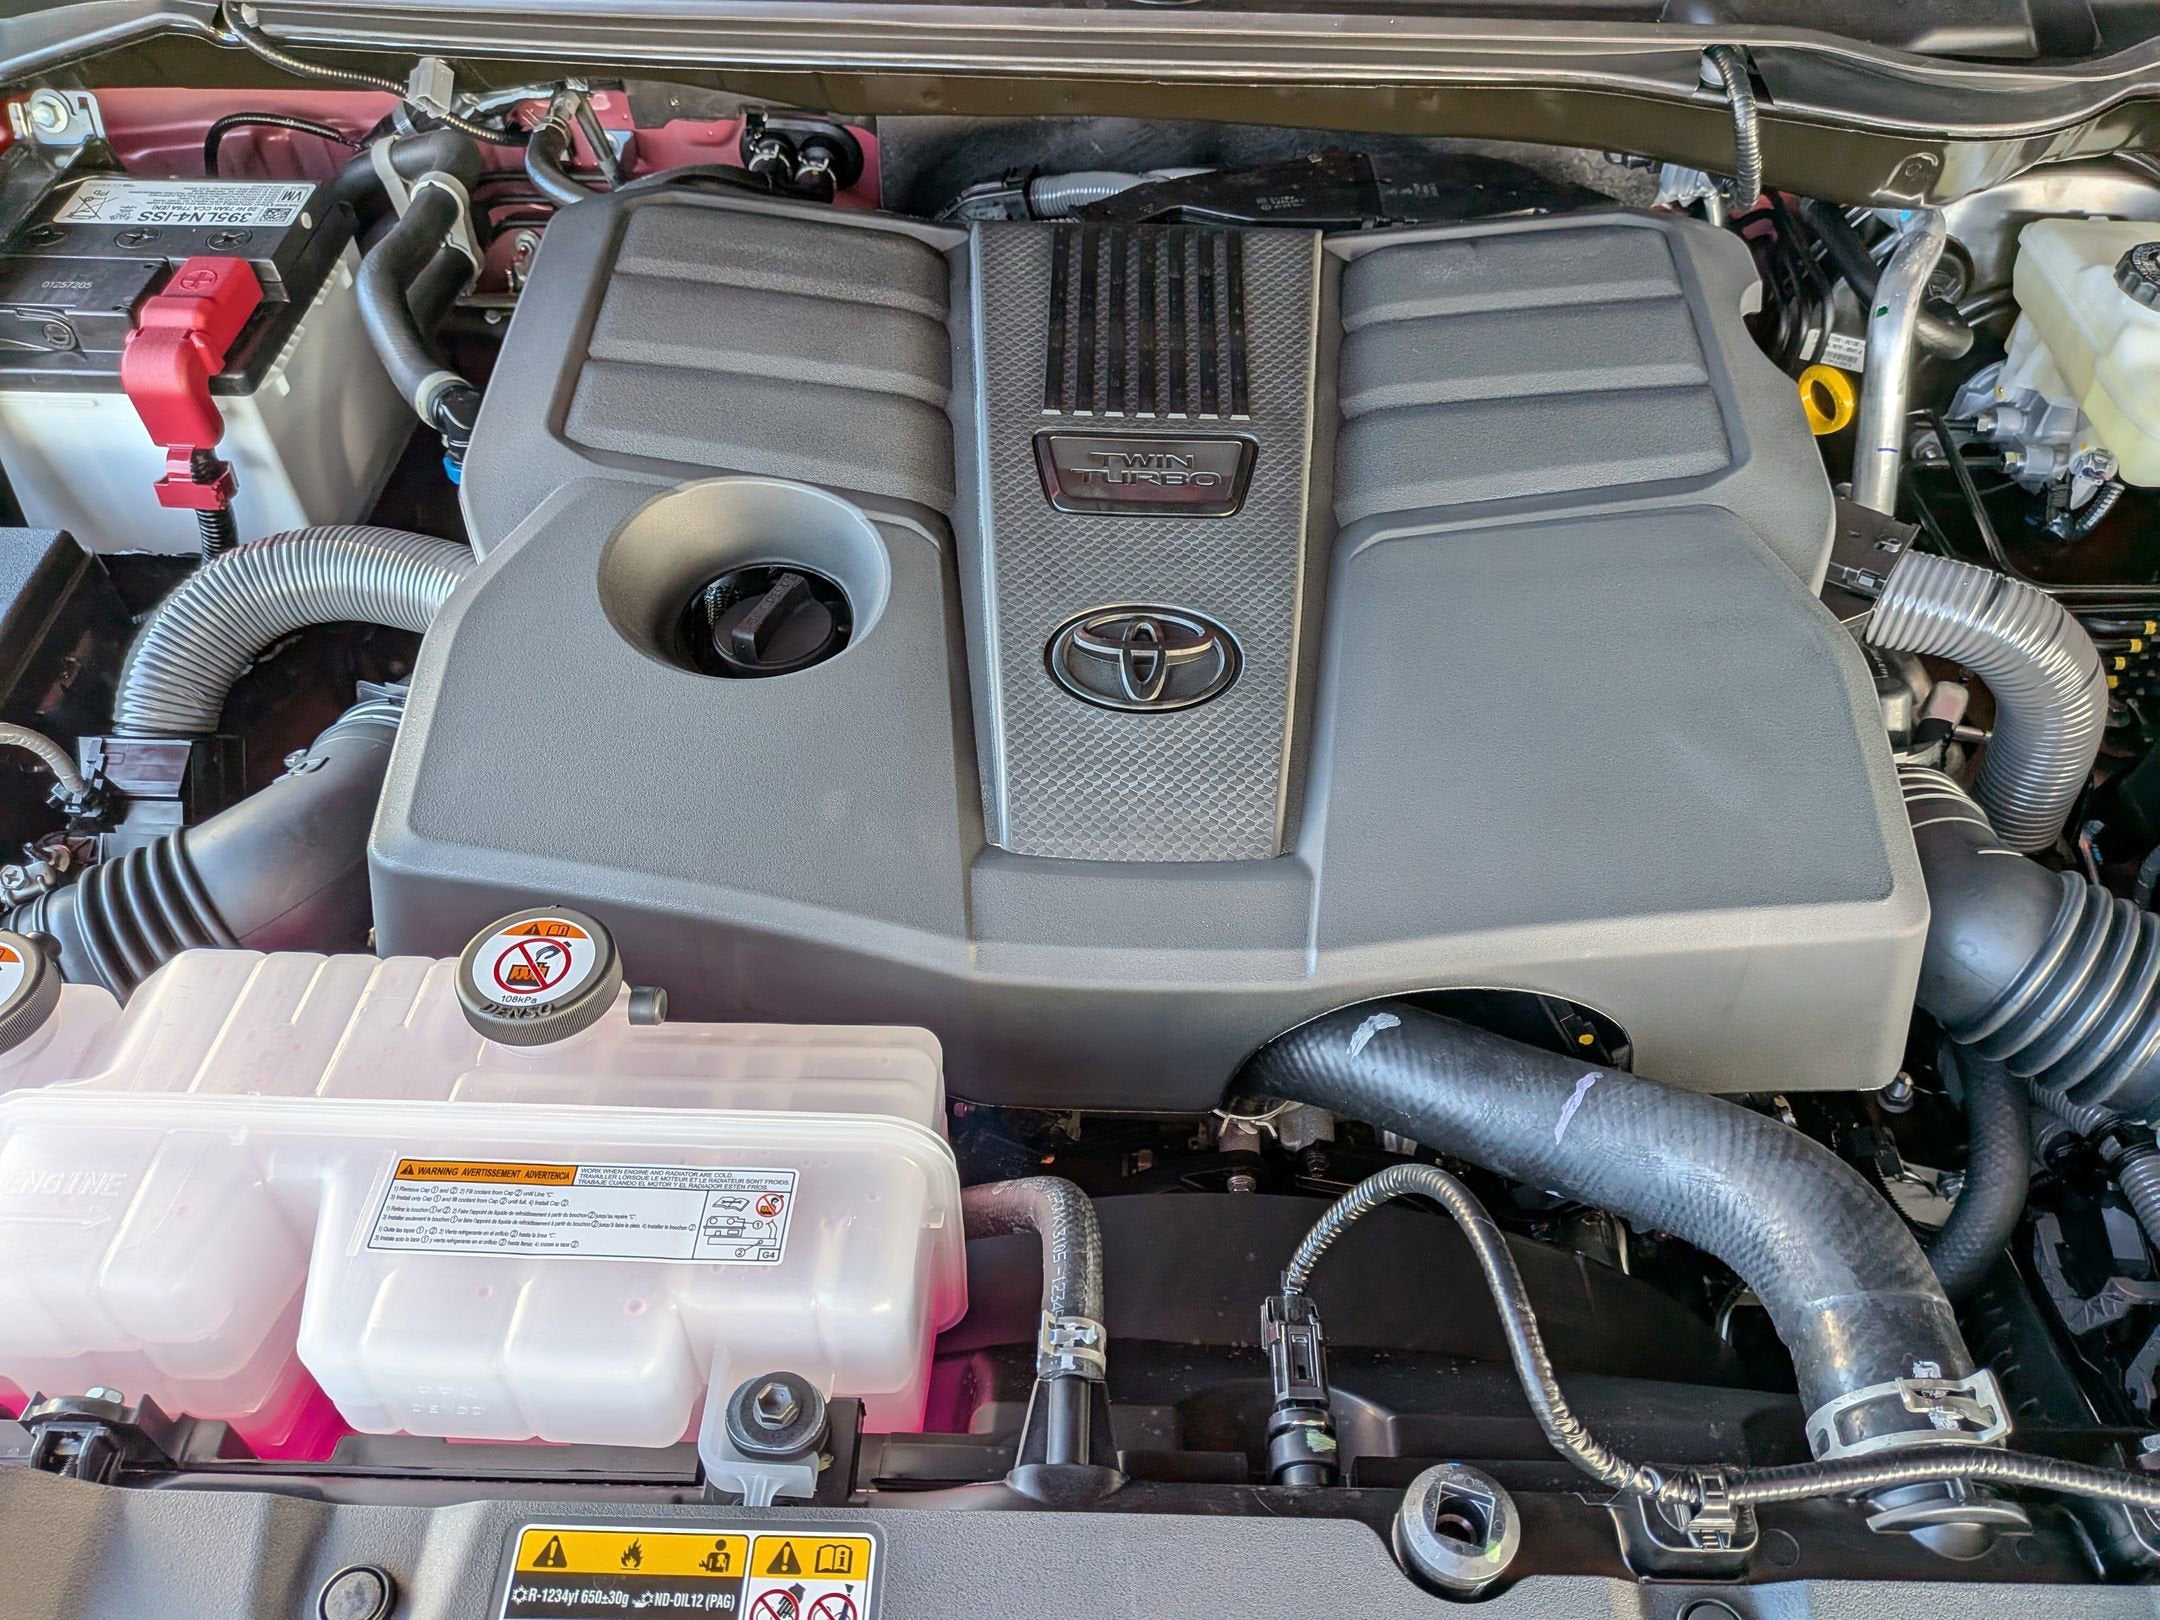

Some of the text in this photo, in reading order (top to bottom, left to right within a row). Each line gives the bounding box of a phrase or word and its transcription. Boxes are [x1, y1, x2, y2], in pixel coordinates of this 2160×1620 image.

[280, 190, 303, 201] VM
[137, 211, 253, 223] 395LN4-ISS
[1090, 451, 1194, 469] TWIN
[1070, 467, 1223, 488] TURBO
[501, 994, 538, 1004] 108kPa
[479, 1002, 554, 1020] DENSO
[417, 1167, 570, 1180] WARNING AVERTISSEMENT ADVERTENCIA
[1, 1170, 128, 1196] ENGINE
[762, 1251, 775, 1259] G4
[528, 1587, 736, 1612] R-1234yf 650±30g ND-OIL12 (PAG)
